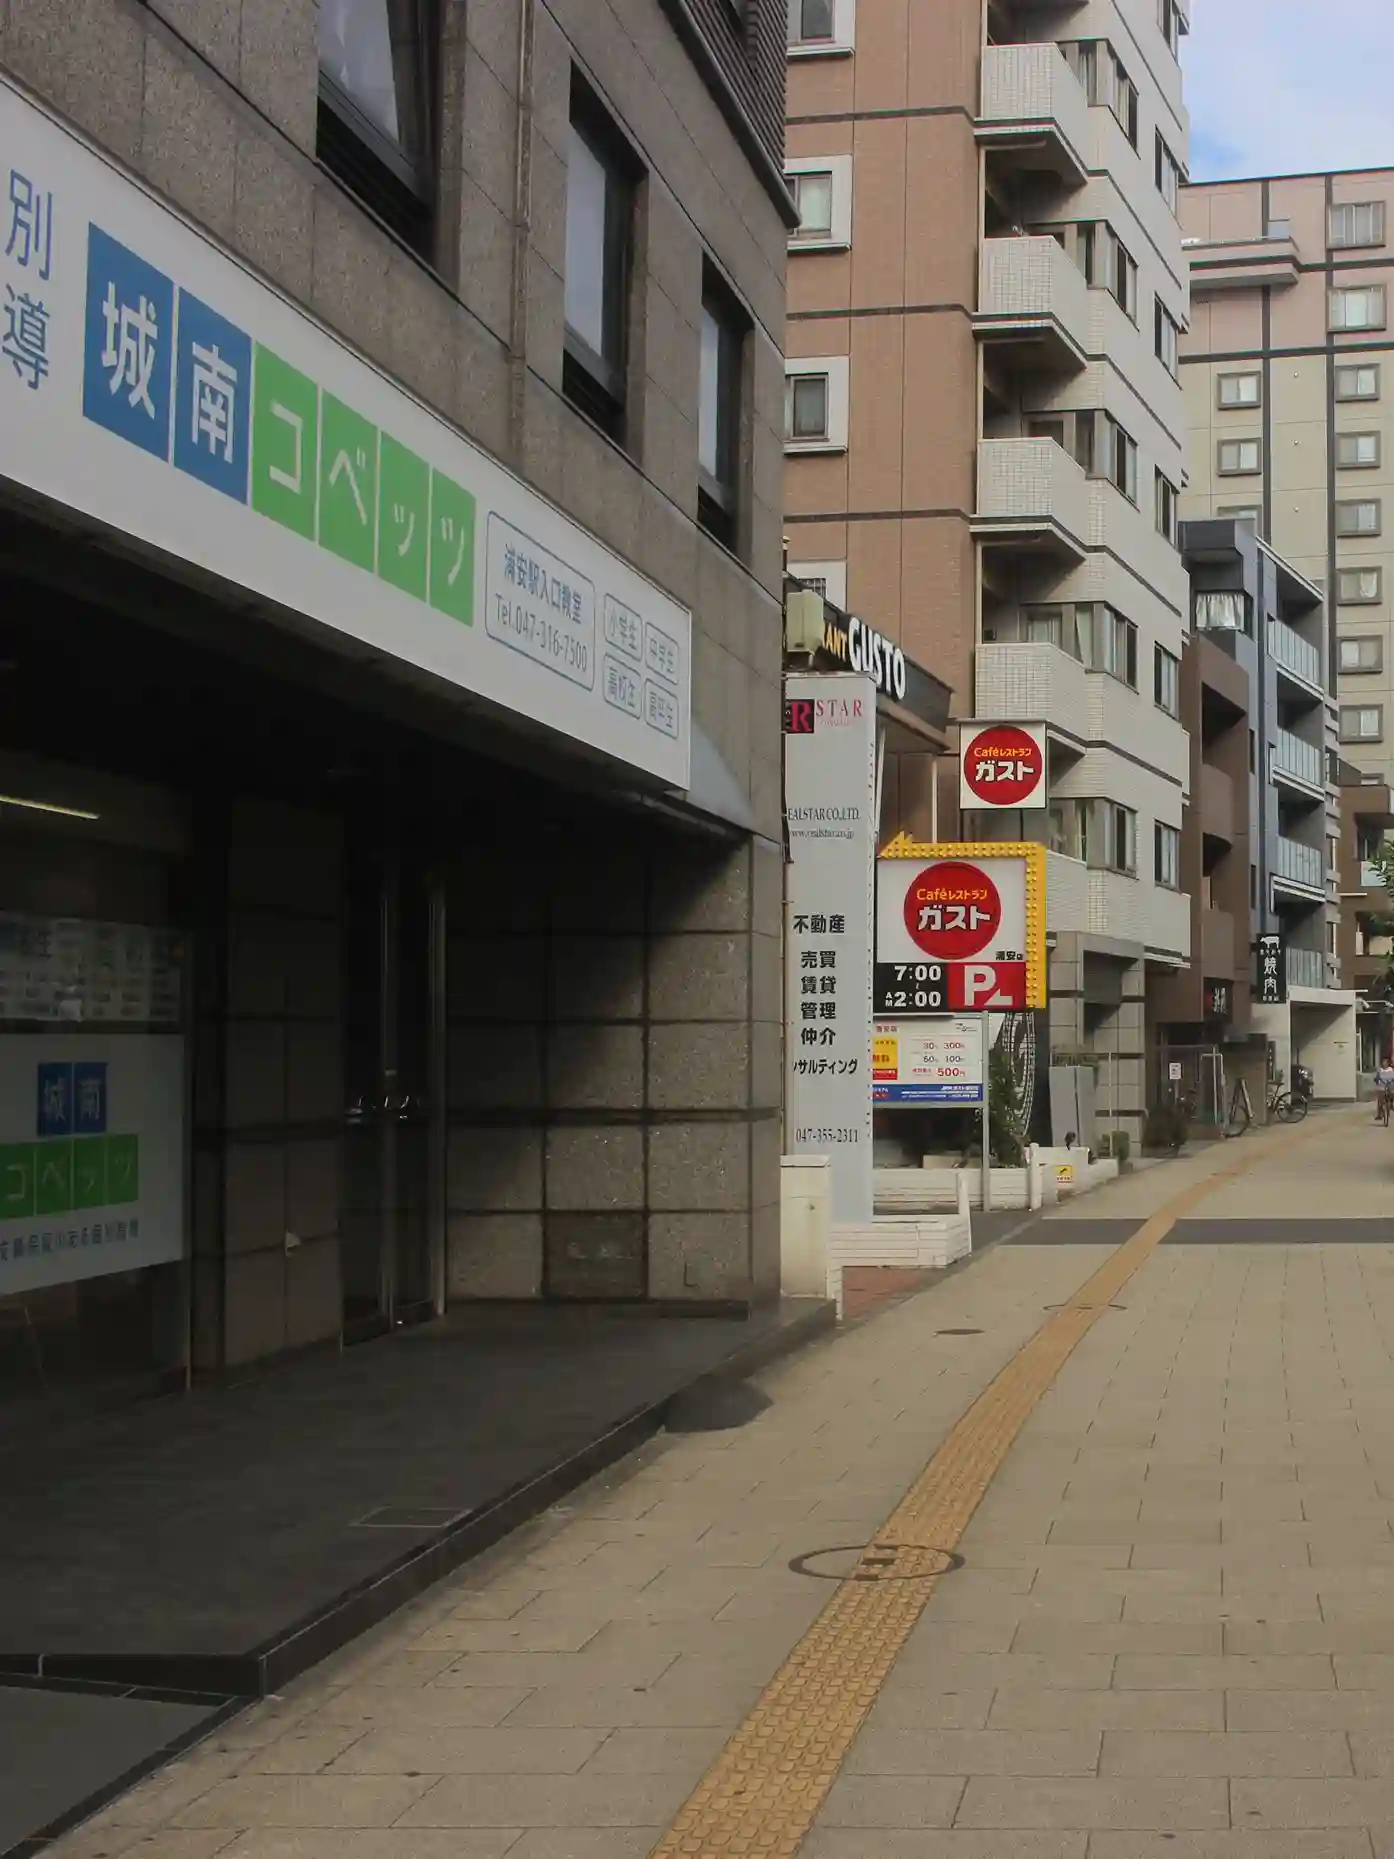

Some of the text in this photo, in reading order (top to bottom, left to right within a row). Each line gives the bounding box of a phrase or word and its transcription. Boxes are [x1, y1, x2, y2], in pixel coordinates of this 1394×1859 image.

[822, 616, 906, 700] ANT GUSTO
[815, 699, 862, 717] STAR
[975, 760, 1034, 782] ガスト
[788, 807, 825, 821] EALSTAR
[792, 914, 845, 934] 不動産
[918, 904, 991, 931] ガスト
[801, 950, 837, 969] 売買
[894, 965, 942, 981] 7:00
[801, 975, 837, 995] 賃貸
[964, 965, 996, 1006] P
[893, 991, 941, 1007] 2:00
[801, 1001, 837, 1020] 管理
[801, 1027, 837, 1046] 仲介
